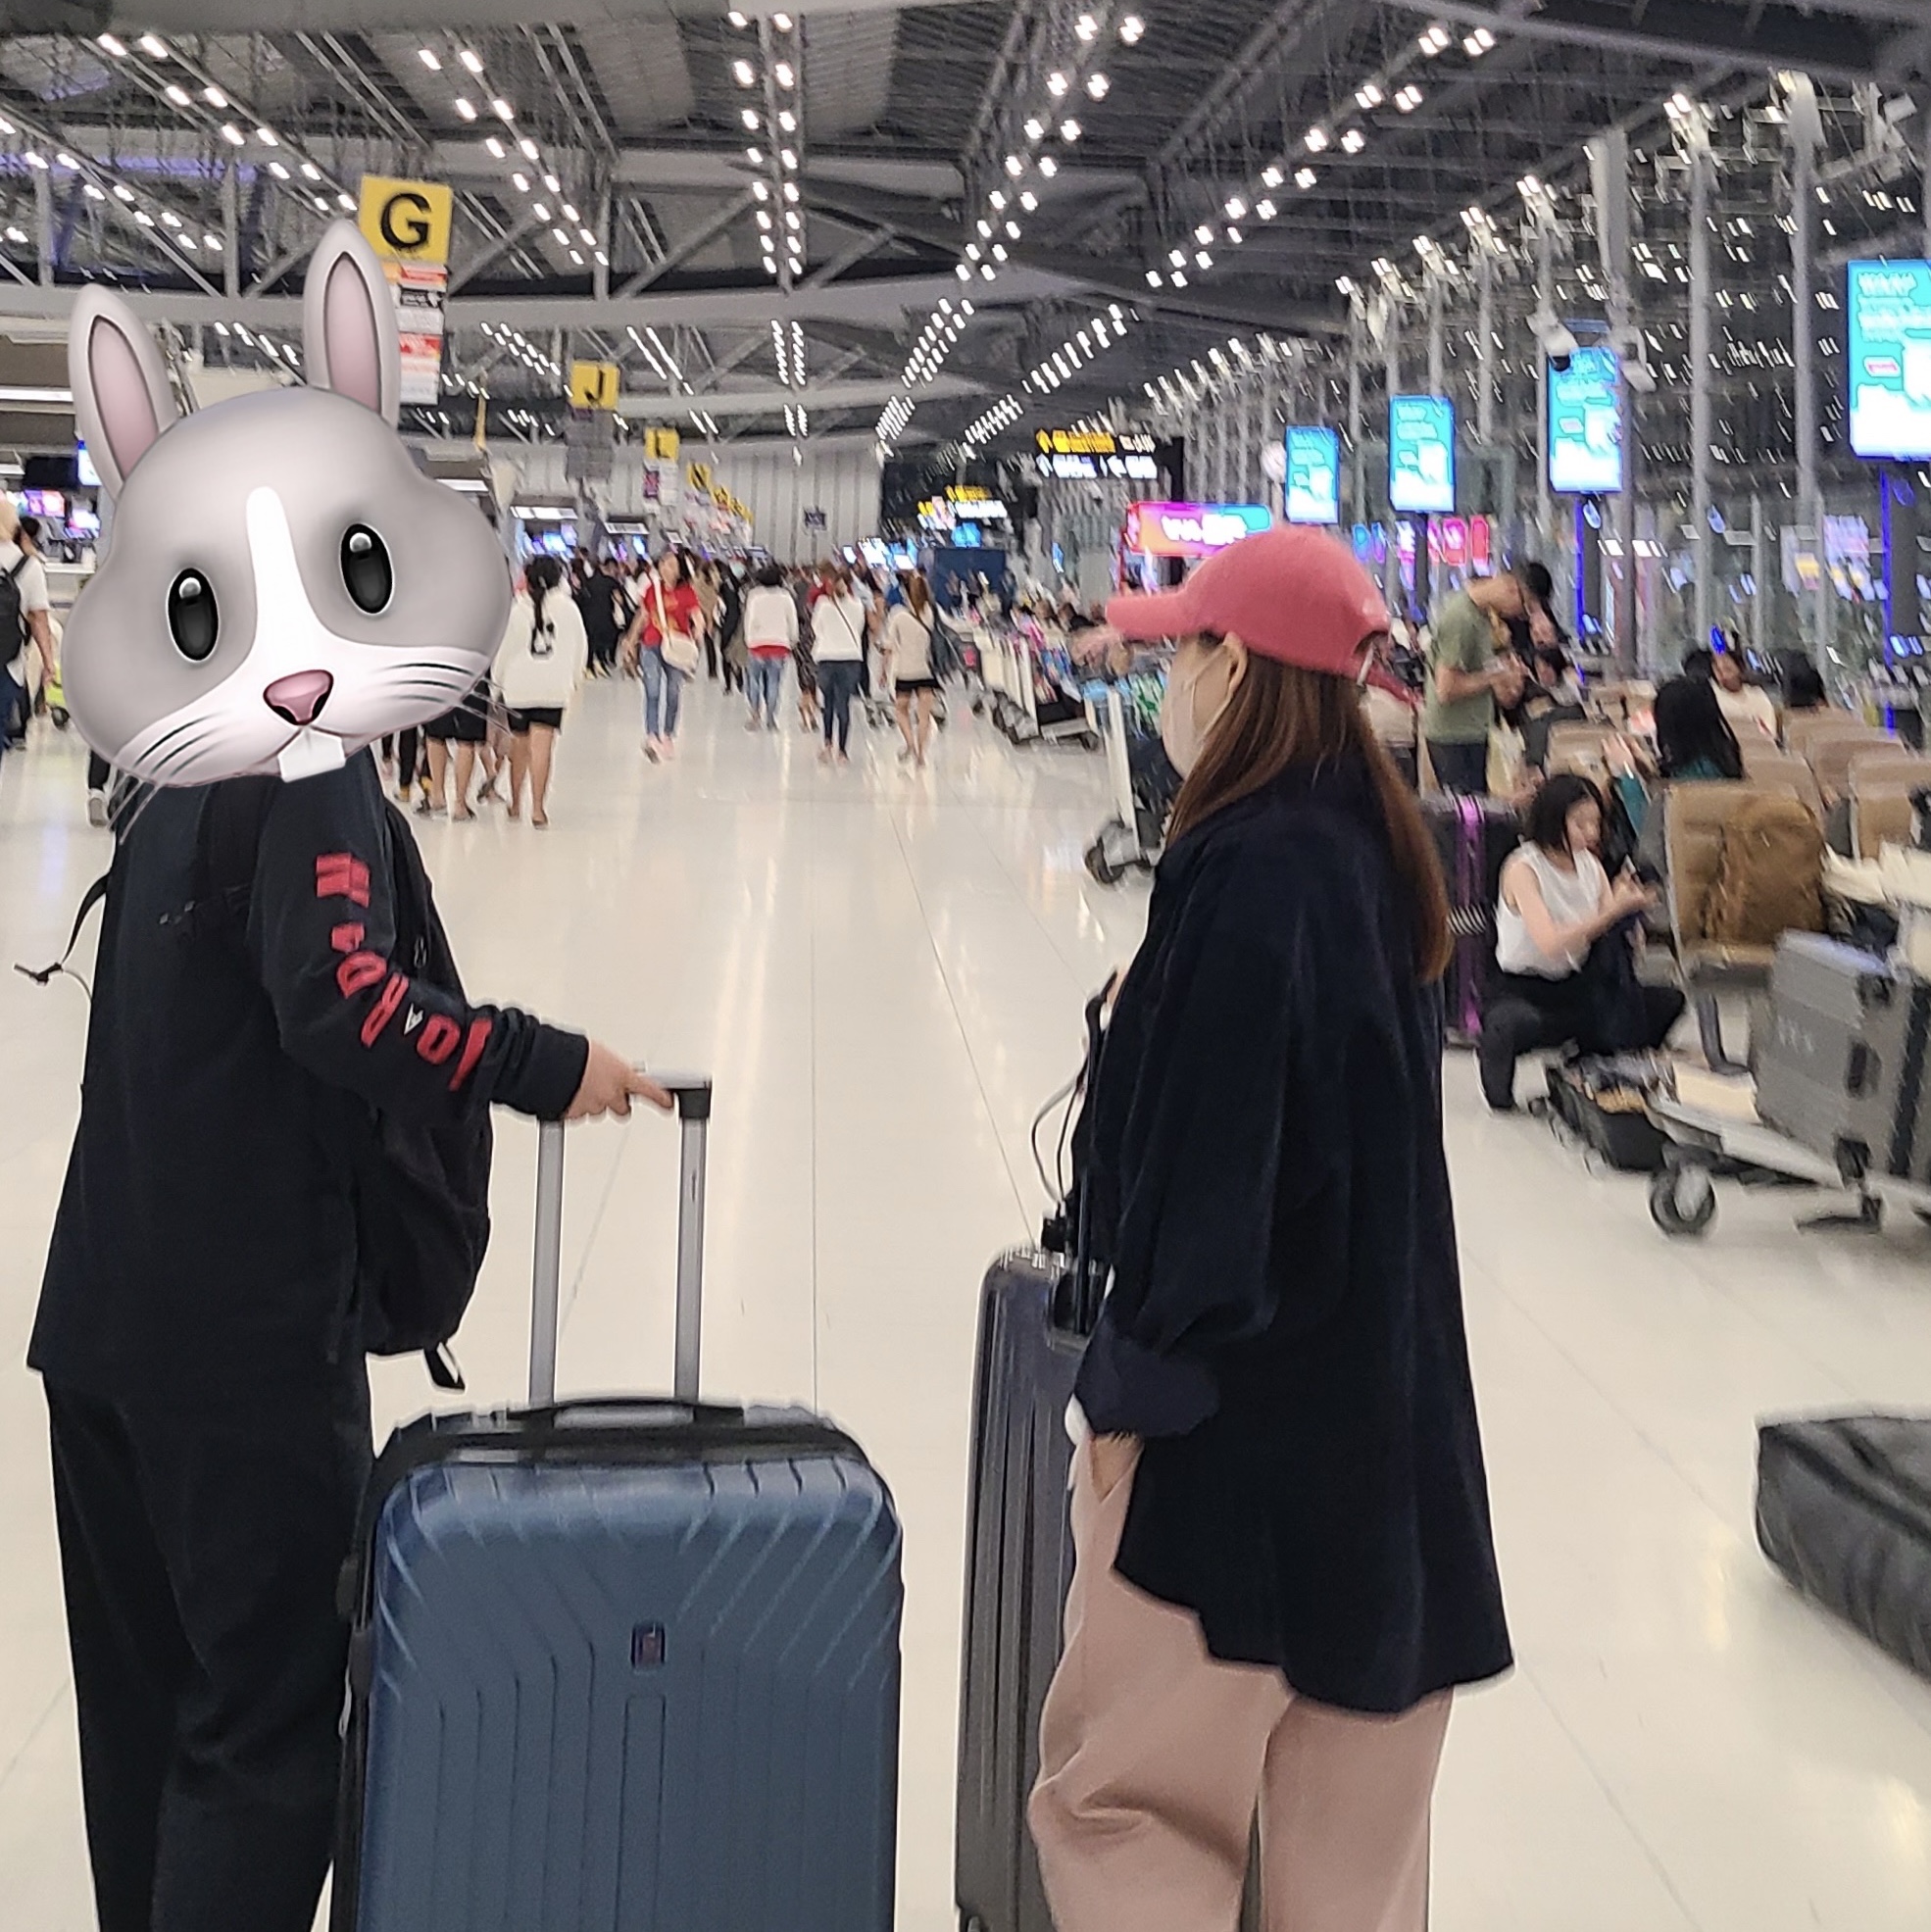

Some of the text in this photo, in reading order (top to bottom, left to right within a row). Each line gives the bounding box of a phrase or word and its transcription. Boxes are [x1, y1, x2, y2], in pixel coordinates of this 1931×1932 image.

[380, 192, 432, 249] G
[583, 369, 606, 405] J
[654, 429, 671, 460] L
